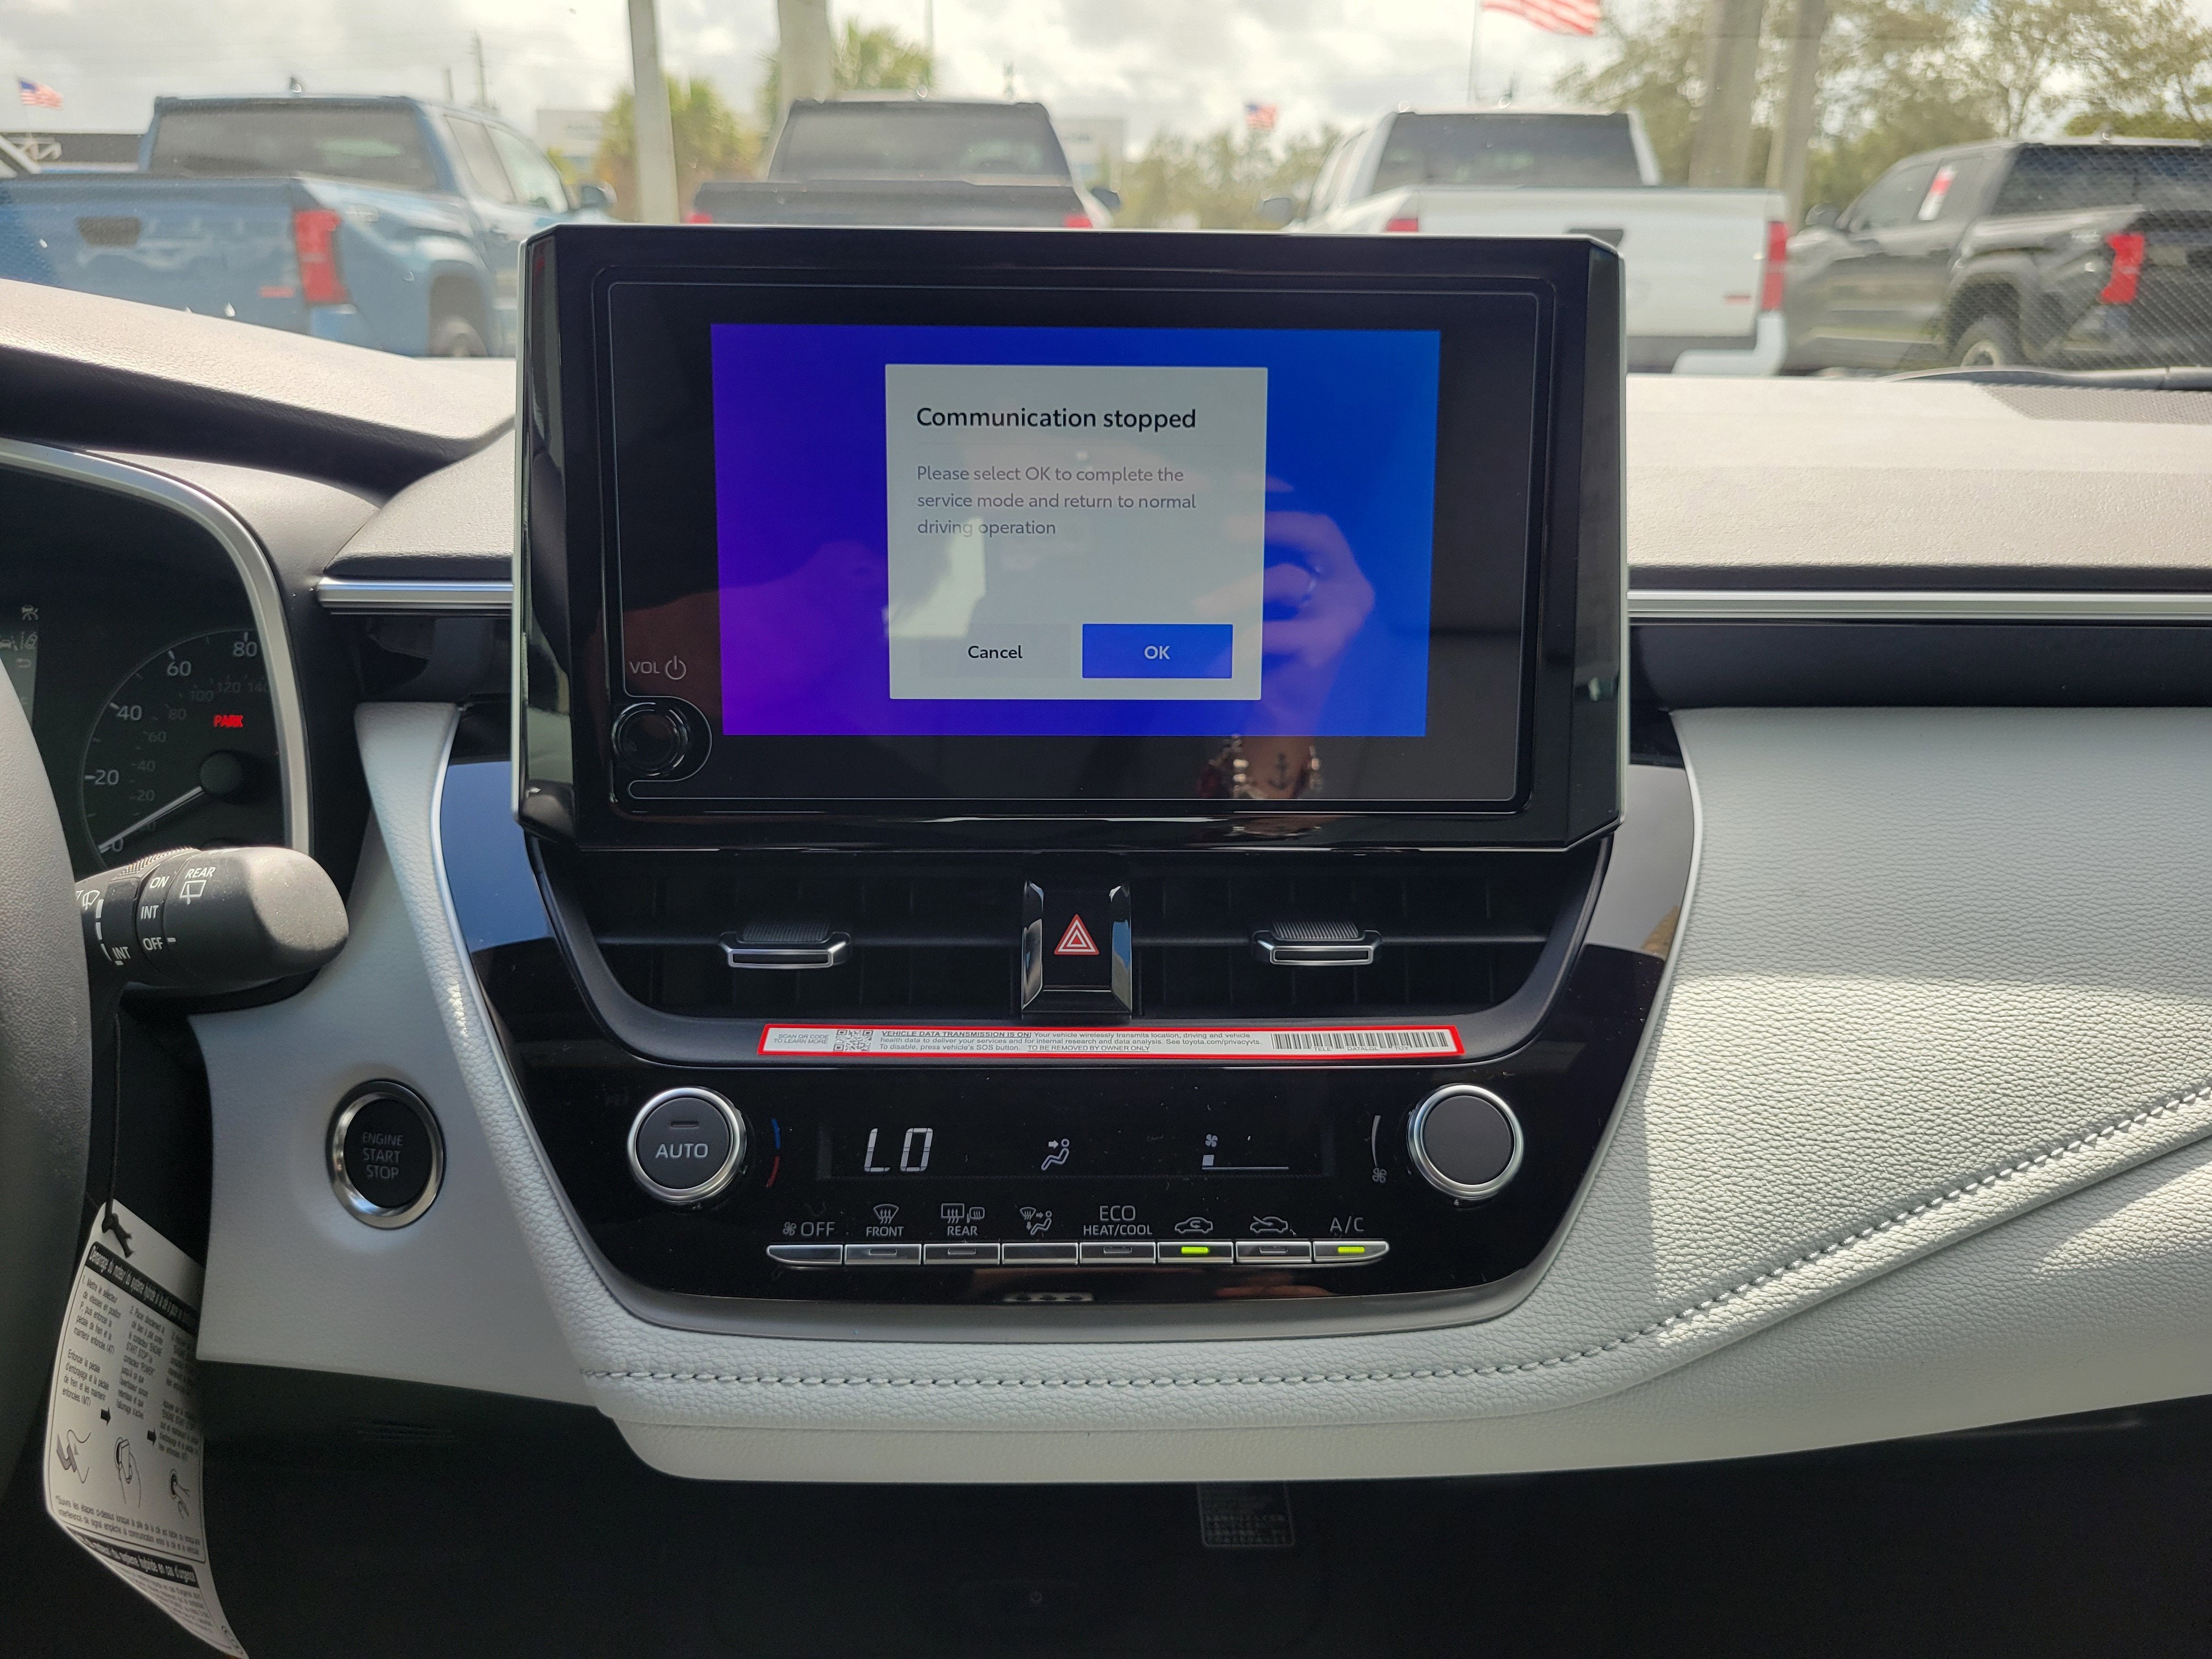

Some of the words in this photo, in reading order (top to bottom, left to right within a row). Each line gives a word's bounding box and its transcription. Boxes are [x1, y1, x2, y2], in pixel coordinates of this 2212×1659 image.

[916, 408, 1096, 427] Communication
[1103, 409, 1196, 432] stopped
[917, 466, 969, 481] Please
[973, 466, 1021, 481] select
[1025, 467, 1051, 481] OK
[1054, 469, 1072, 482] to
[1076, 467, 1153, 485] complete
[1157, 467, 1184, 482] the
[917, 494, 973, 508] service
[977, 494, 1024, 508] mode
[1029, 494, 1059, 509] and
[1064, 495, 1113, 509] return
[1118, 495, 1134, 509] to
[1138, 494, 1196, 509] normal
[917, 520, 973, 538] driving
[978, 520, 1056, 538] operation
[233, 641, 258, 658] 80
[968, 645, 1023, 660] Cancel
[1144, 645, 1170, 661] OK
[166, 660, 191, 677] 60
[630, 661, 661, 674] VOL
[218, 682, 241, 693] 120
[191, 691, 214, 702] 100
[116, 705, 142, 721] 40
[168, 708, 187, 721] 80
[213, 714, 244, 729] PARK
[148, 731, 167, 743] 60
[139, 760, 156, 772] 40
[94, 769, 120, 786] 20
[138, 789, 155, 802] 20
[111, 837, 124, 852] 0
[184, 867, 217, 879] REAR
[149, 876, 170, 889] ON
[140, 905, 159, 919] INT
[142, 937, 163, 951] OFF
[112, 946, 132, 960] INT
[362, 1132, 404, 1146] ENGINE
[363, 1148, 401, 1163] START
[655, 1143, 708, 1159] AUTO
[864, 1127, 933, 1172] LO
[366, 1165, 399, 1178] STOP
[1099, 1205, 1136, 1222] ECO
[800, 1222, 835, 1237] OFF
[866, 1226, 904, 1237] FRONT
[947, 1224, 978, 1236] REAR
[1083, 1224, 1153, 1236] HEAT/COOL
[1329, 1217, 1365, 1233] A/C
